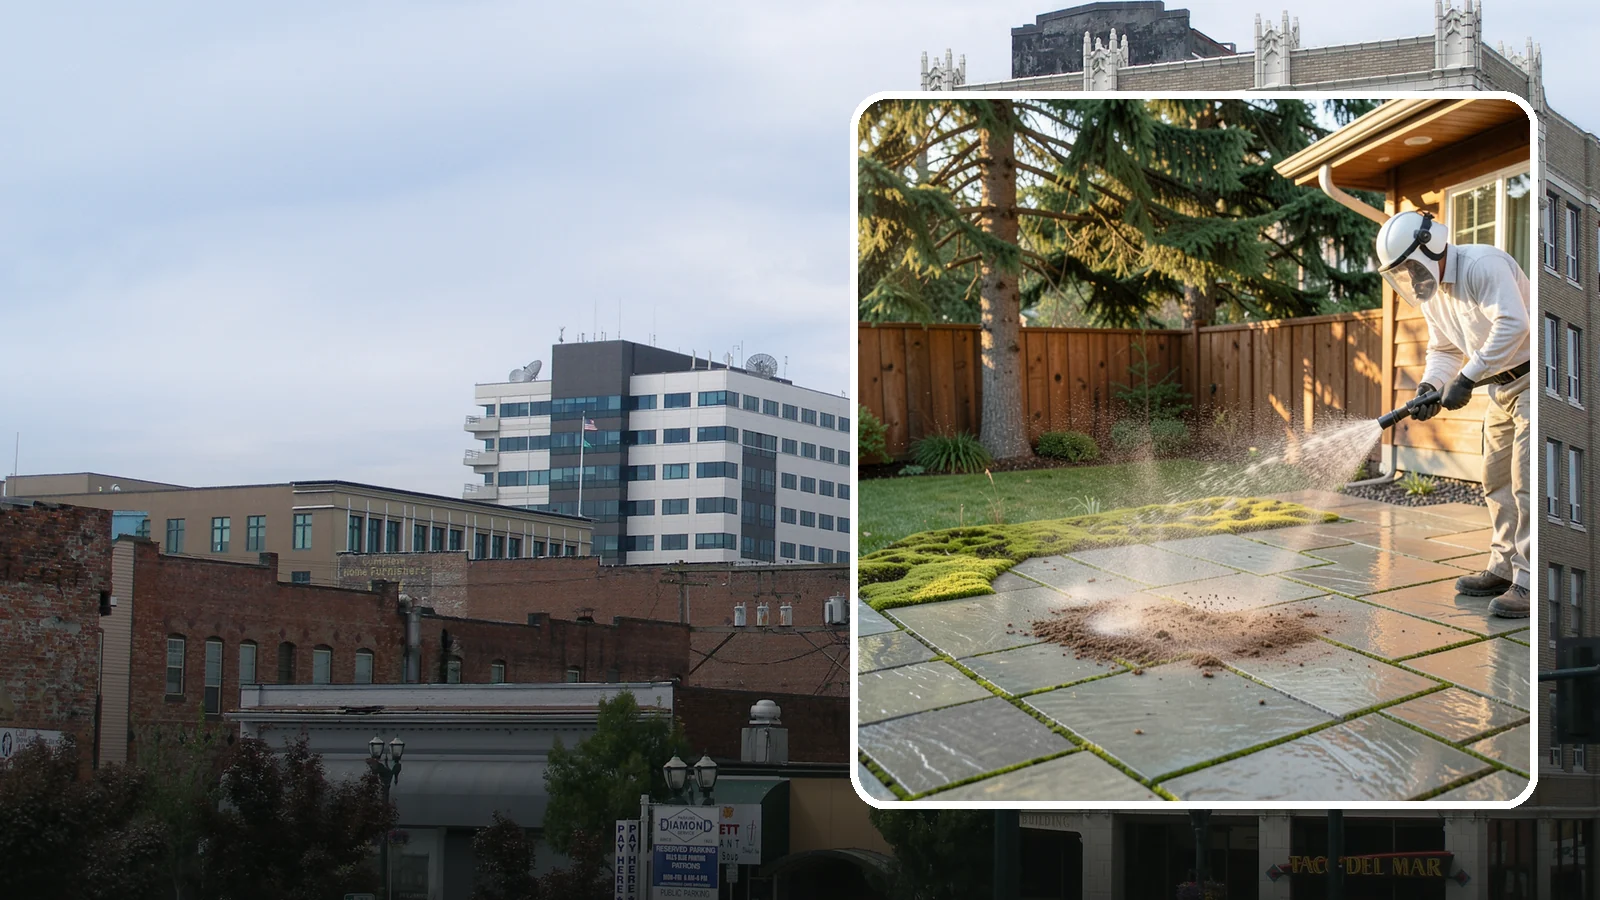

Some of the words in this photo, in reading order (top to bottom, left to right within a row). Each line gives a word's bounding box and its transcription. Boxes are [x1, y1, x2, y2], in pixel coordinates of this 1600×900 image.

[370, 566, 427, 577] Furnishers
[660, 818, 713, 833] DIAMOND
[1022, 815, 1070, 828] BUILDING
[617, 825, 625, 853] PAY
[628, 824, 637, 853] PAY
[656, 845, 688, 853] RESERVED
[689, 846, 716, 854] PARKING
[671, 862, 701, 870] PATRONS
[1289, 855, 1329, 874] TAC
[1346, 856, 1385, 875] DEL
[1391, 857, 1442, 877] MAR
[616, 856, 625, 894] HERE
[627, 856, 637, 894] HERE
[660, 888, 682, 897] PUBLIC
[683, 889, 710, 898] PARKING
